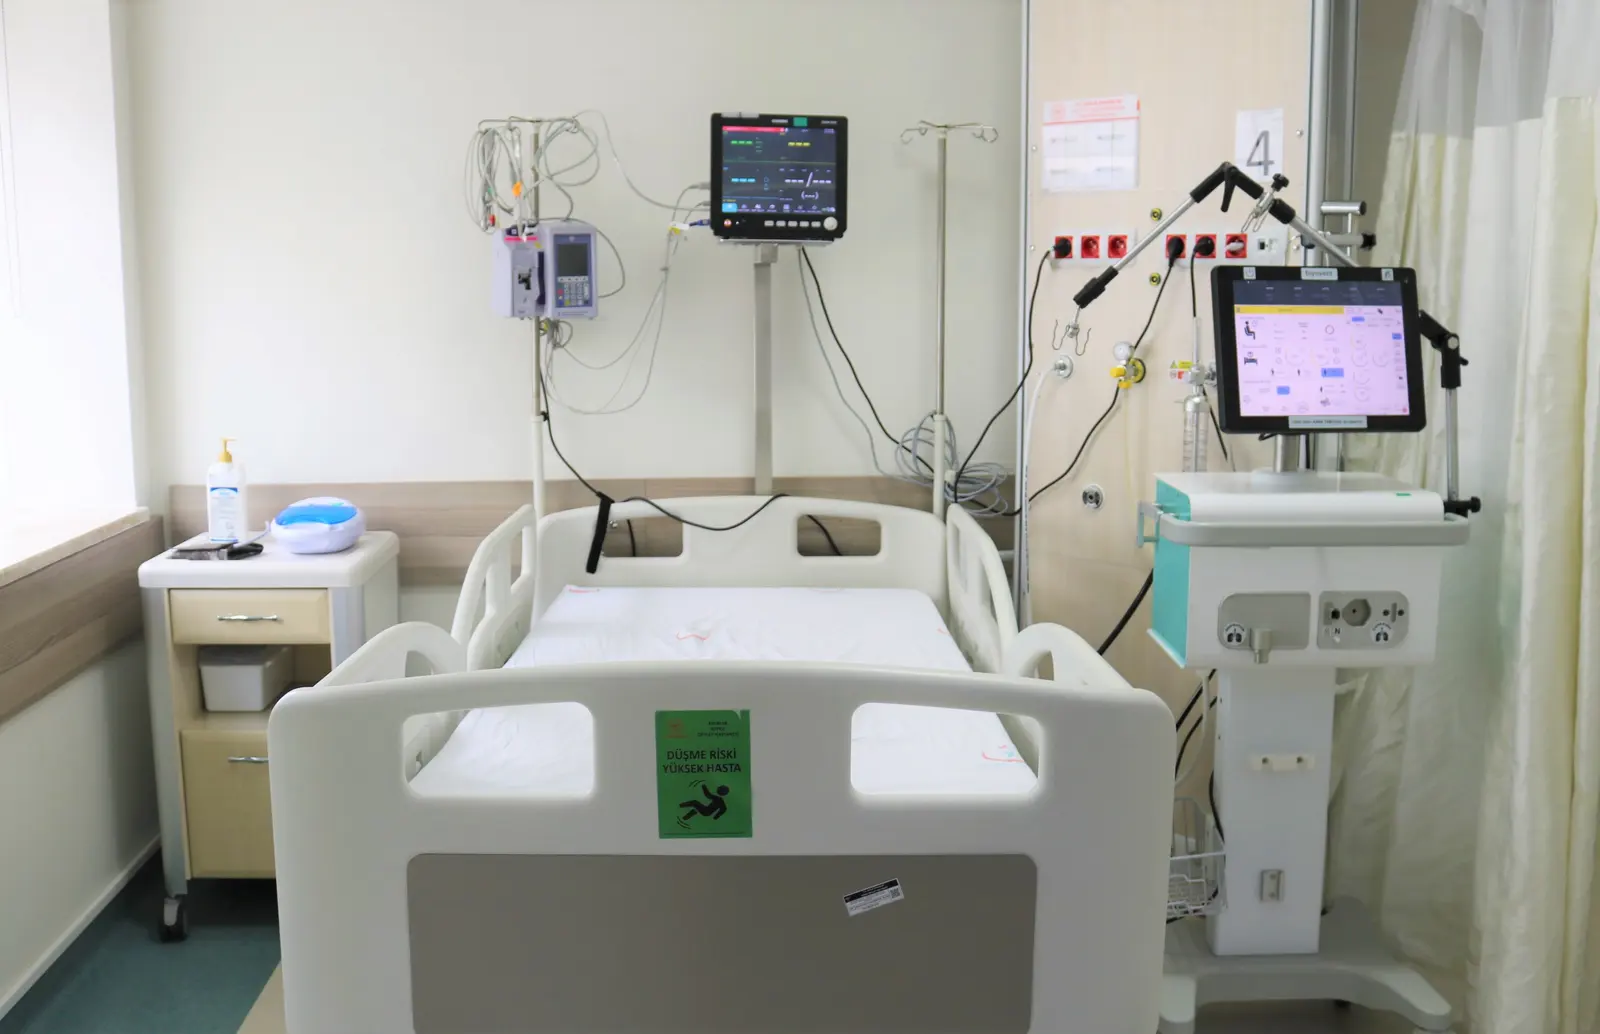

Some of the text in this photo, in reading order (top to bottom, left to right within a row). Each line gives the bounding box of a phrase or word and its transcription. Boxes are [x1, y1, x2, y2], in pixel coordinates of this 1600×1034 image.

[1246, 130, 1275, 176] 4
[667, 748, 737, 762] DÜŞME RİSKİ
[663, 762, 741, 773] YÜKSEK HASTA
